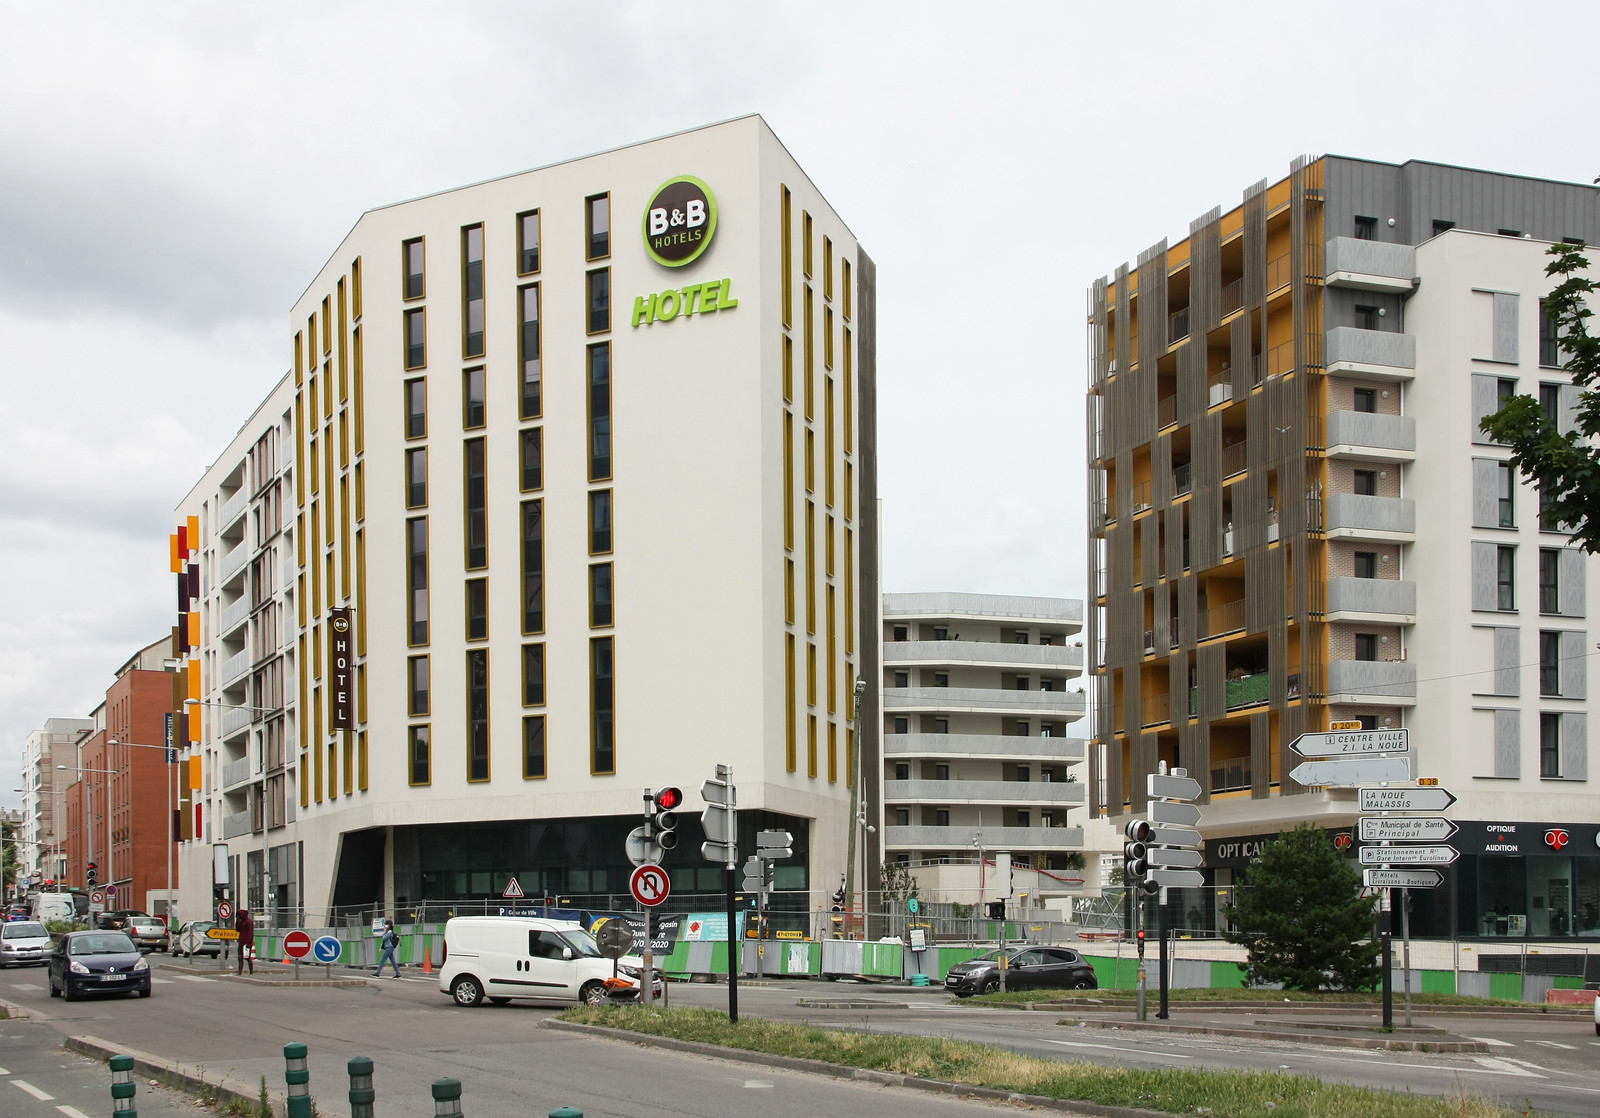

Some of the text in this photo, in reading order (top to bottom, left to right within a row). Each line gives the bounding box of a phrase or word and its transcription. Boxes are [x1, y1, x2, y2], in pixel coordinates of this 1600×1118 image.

[650, 199, 707, 237] B&B
[655, 229, 702, 249] HOTELS
[631, 278, 739, 328] HOTEL
[337, 640, 346, 720] HOTEL
[1338, 732, 1403, 743] CENTRE VILLE
[1378, 741, 1403, 749] NOUE
[1365, 800, 1411, 808] MALASSIS
[1380, 821, 1411, 830] Municipal
[1425, 820, 1444, 828] Santé
[1486, 825, 1516, 833] OPTIQUE
[1378, 830, 1420, 838] Principal
[1485, 844, 1518, 852] AUDITION
[499, 907, 505, 916] P
